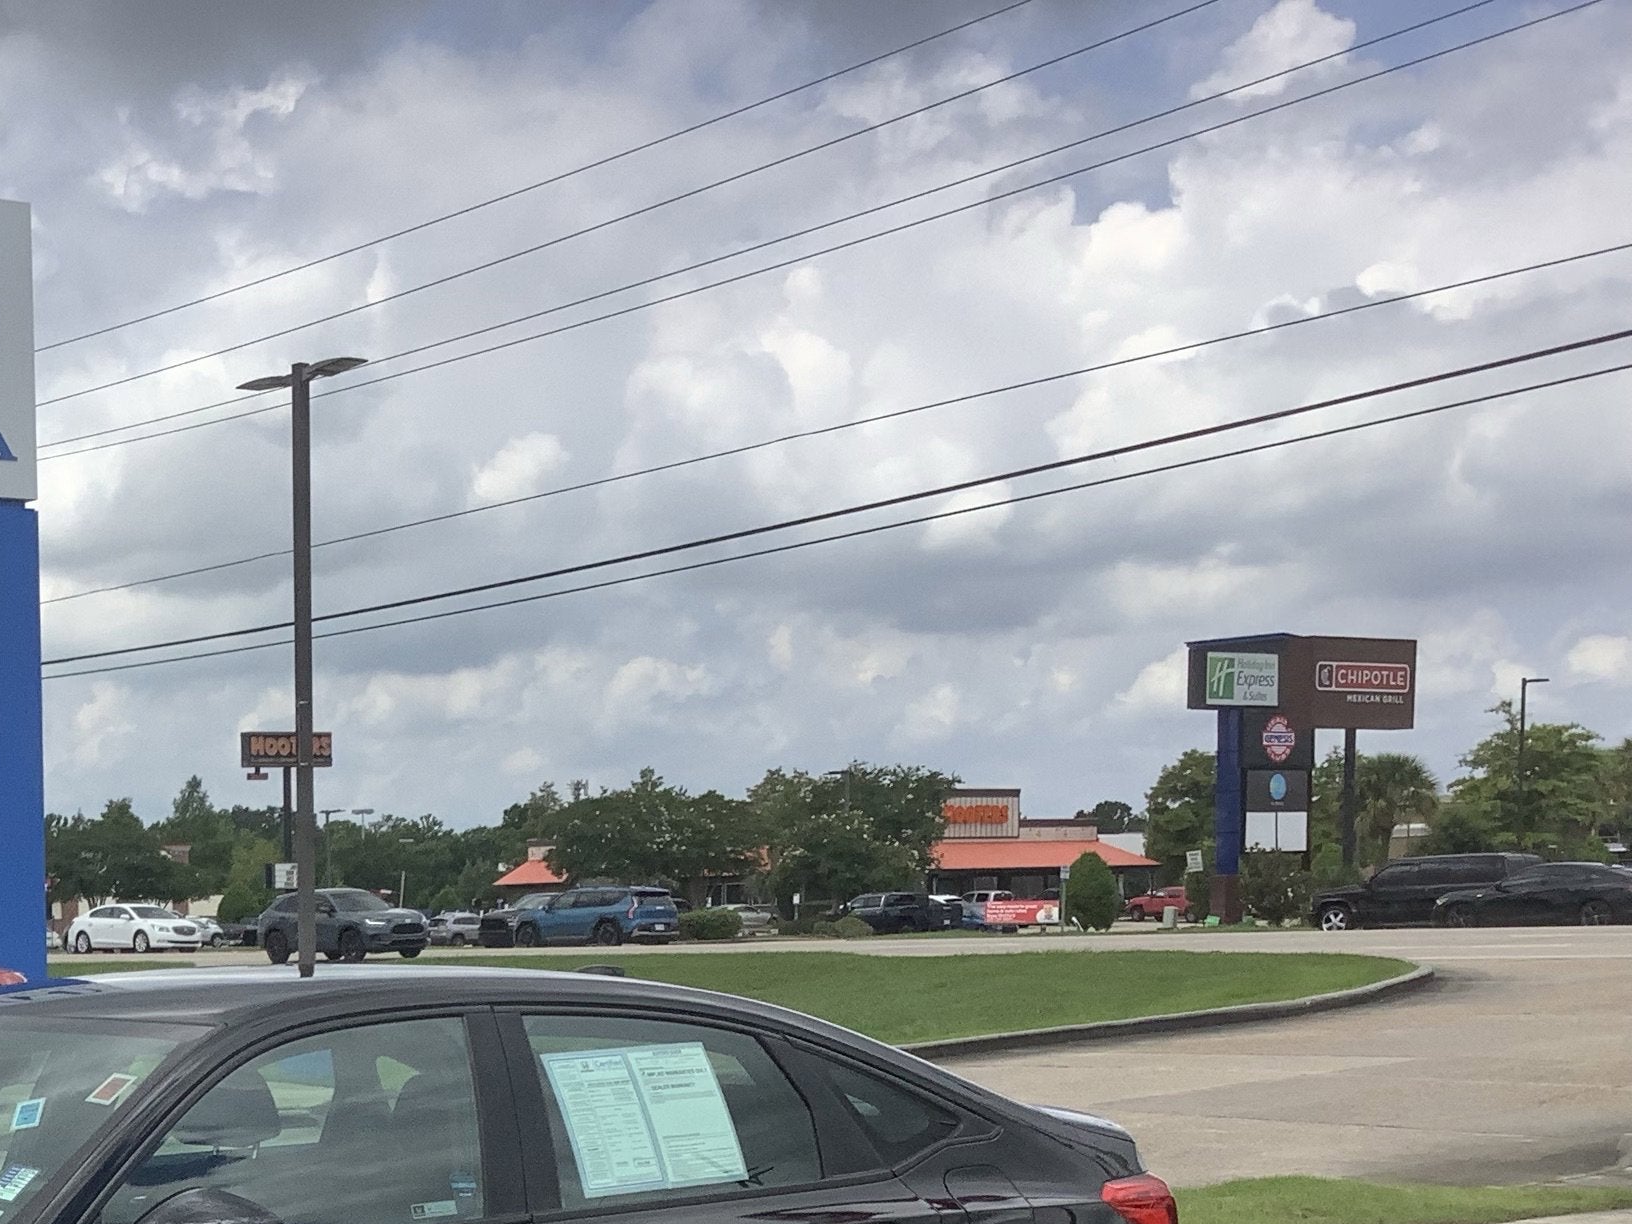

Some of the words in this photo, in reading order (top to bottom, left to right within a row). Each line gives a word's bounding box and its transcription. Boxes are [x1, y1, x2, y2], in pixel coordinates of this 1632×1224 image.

[1237, 670, 1275, 690] Express
[1337, 669, 1405, 686] CHIPOTLE
[1346, 694, 1381, 703] MEXICAN
[1382, 695, 1404, 704] GRILL
[250, 736, 330, 756] HOOTRS
